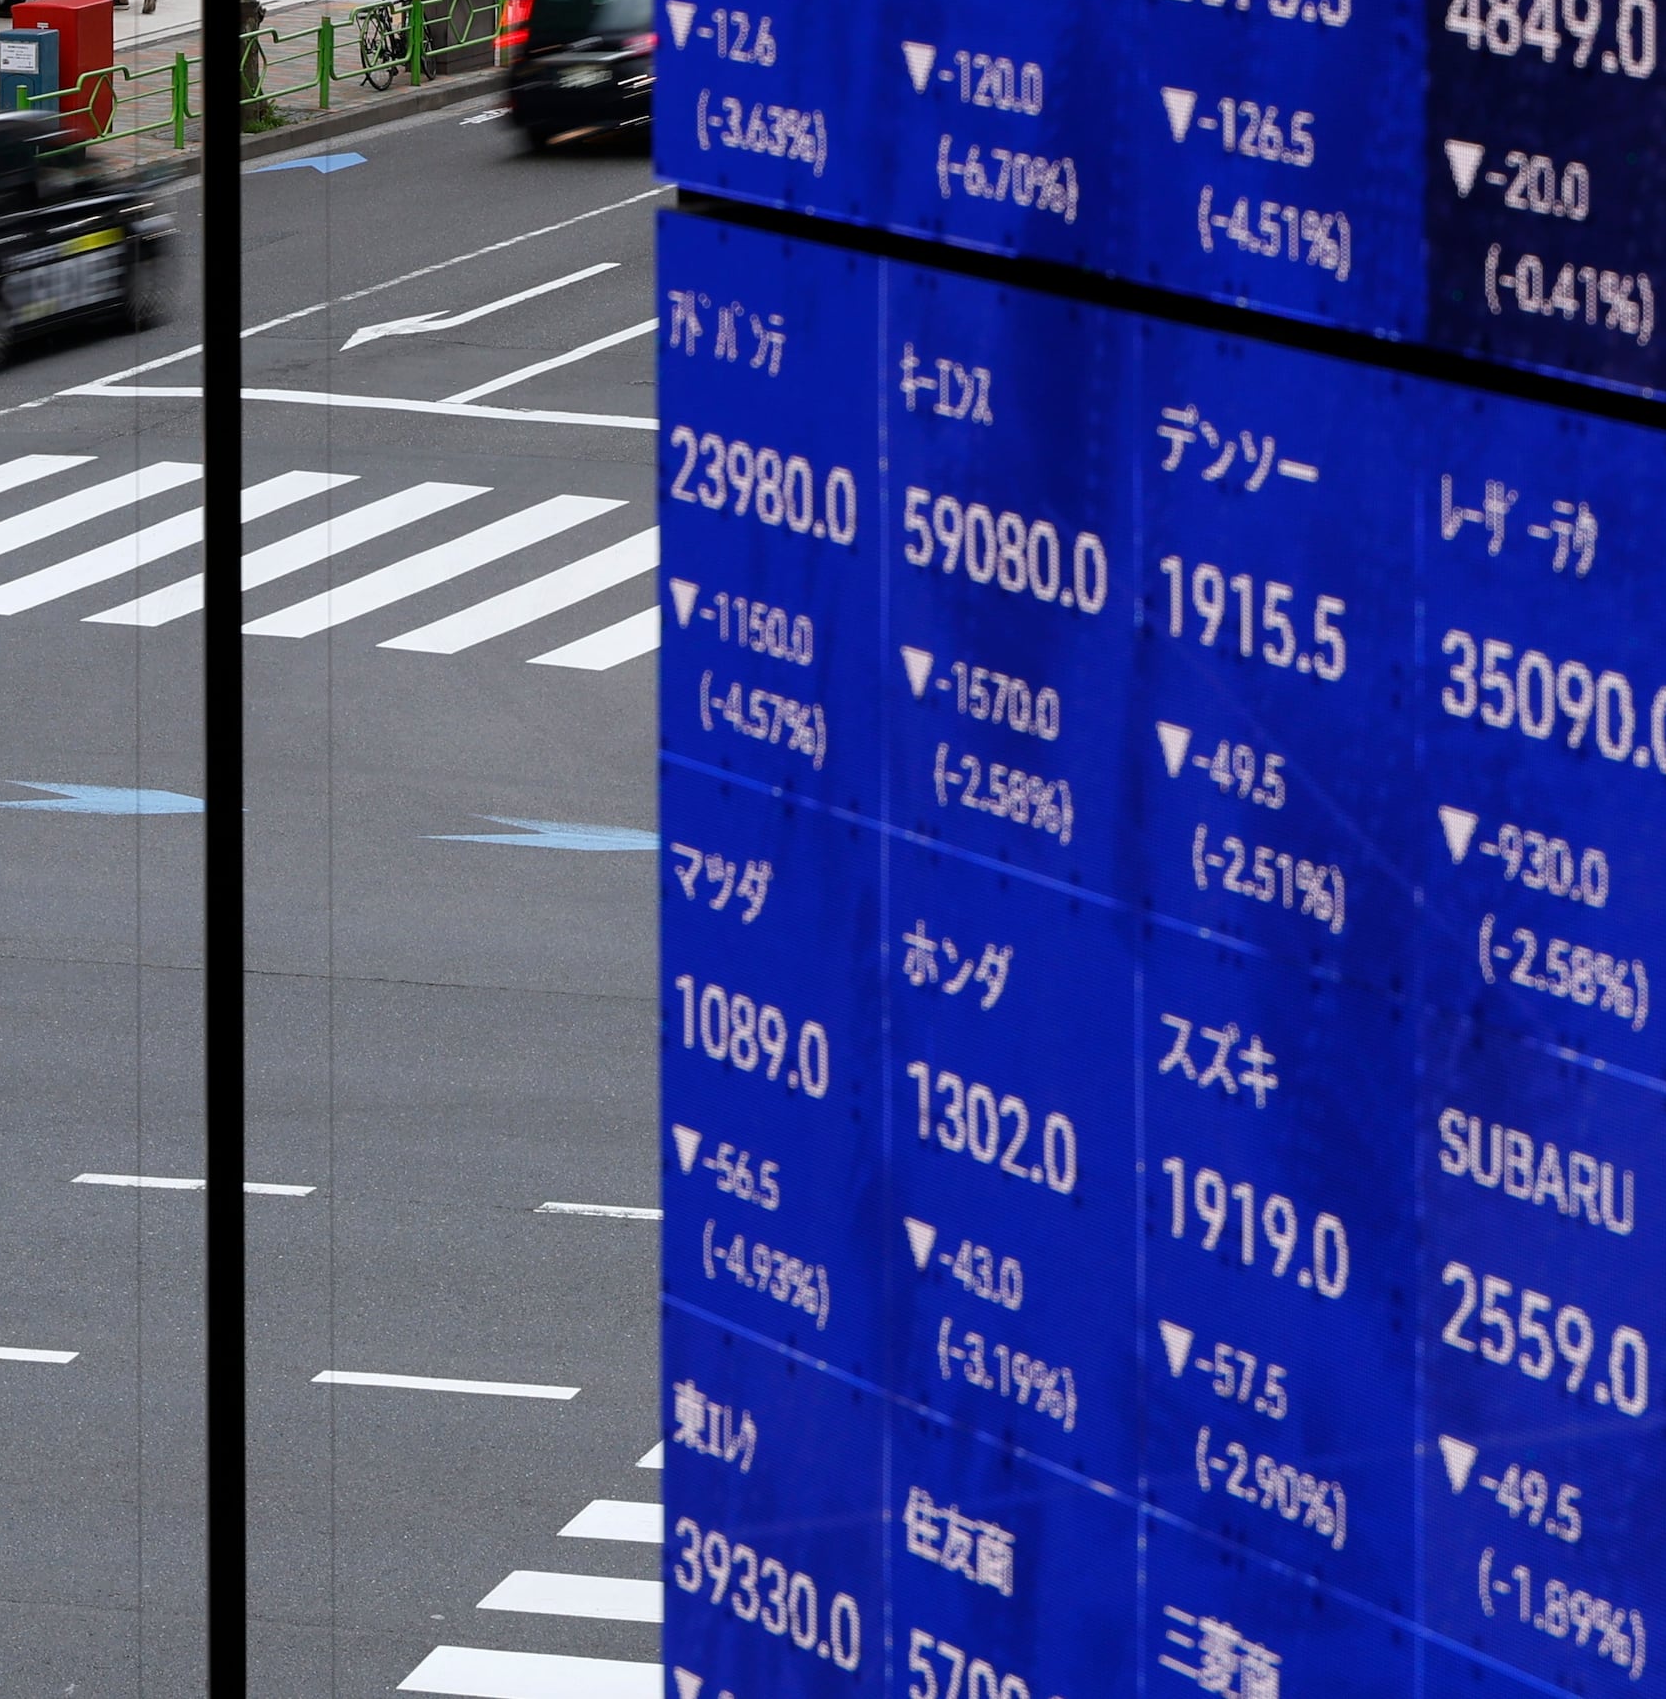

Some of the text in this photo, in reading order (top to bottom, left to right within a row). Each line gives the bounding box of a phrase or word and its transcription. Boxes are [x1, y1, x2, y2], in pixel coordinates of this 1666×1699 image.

[1488, 152, 1588, 220] -20.0
[671, 426, 856, 544] 23980.0
[1158, 407, 1318, 491] デンソー
[905, 487, 1106, 614] 59080.0
[1161, 556, 1345, 680] 1915.5
[672, 843, 771, 922] マツダ
[1482, 824, 1608, 907] -930.0
[904, 923, 1012, 1008] ホンダ
[676, 975, 828, 1098] 1089.0
[1159, 1014, 1277, 1105] スズキ
[908, 1061, 1076, 1193] 1302.0
[1439, 1108, 1633, 1234] SUBARU
[1163, 1157, 1348, 1298] 1919.0
[1442, 1261, 1647, 1416] 2559.0
[1481, 1466, 1581, 1541] -49.5
[675, 1517, 860, 1670] 39330.0
